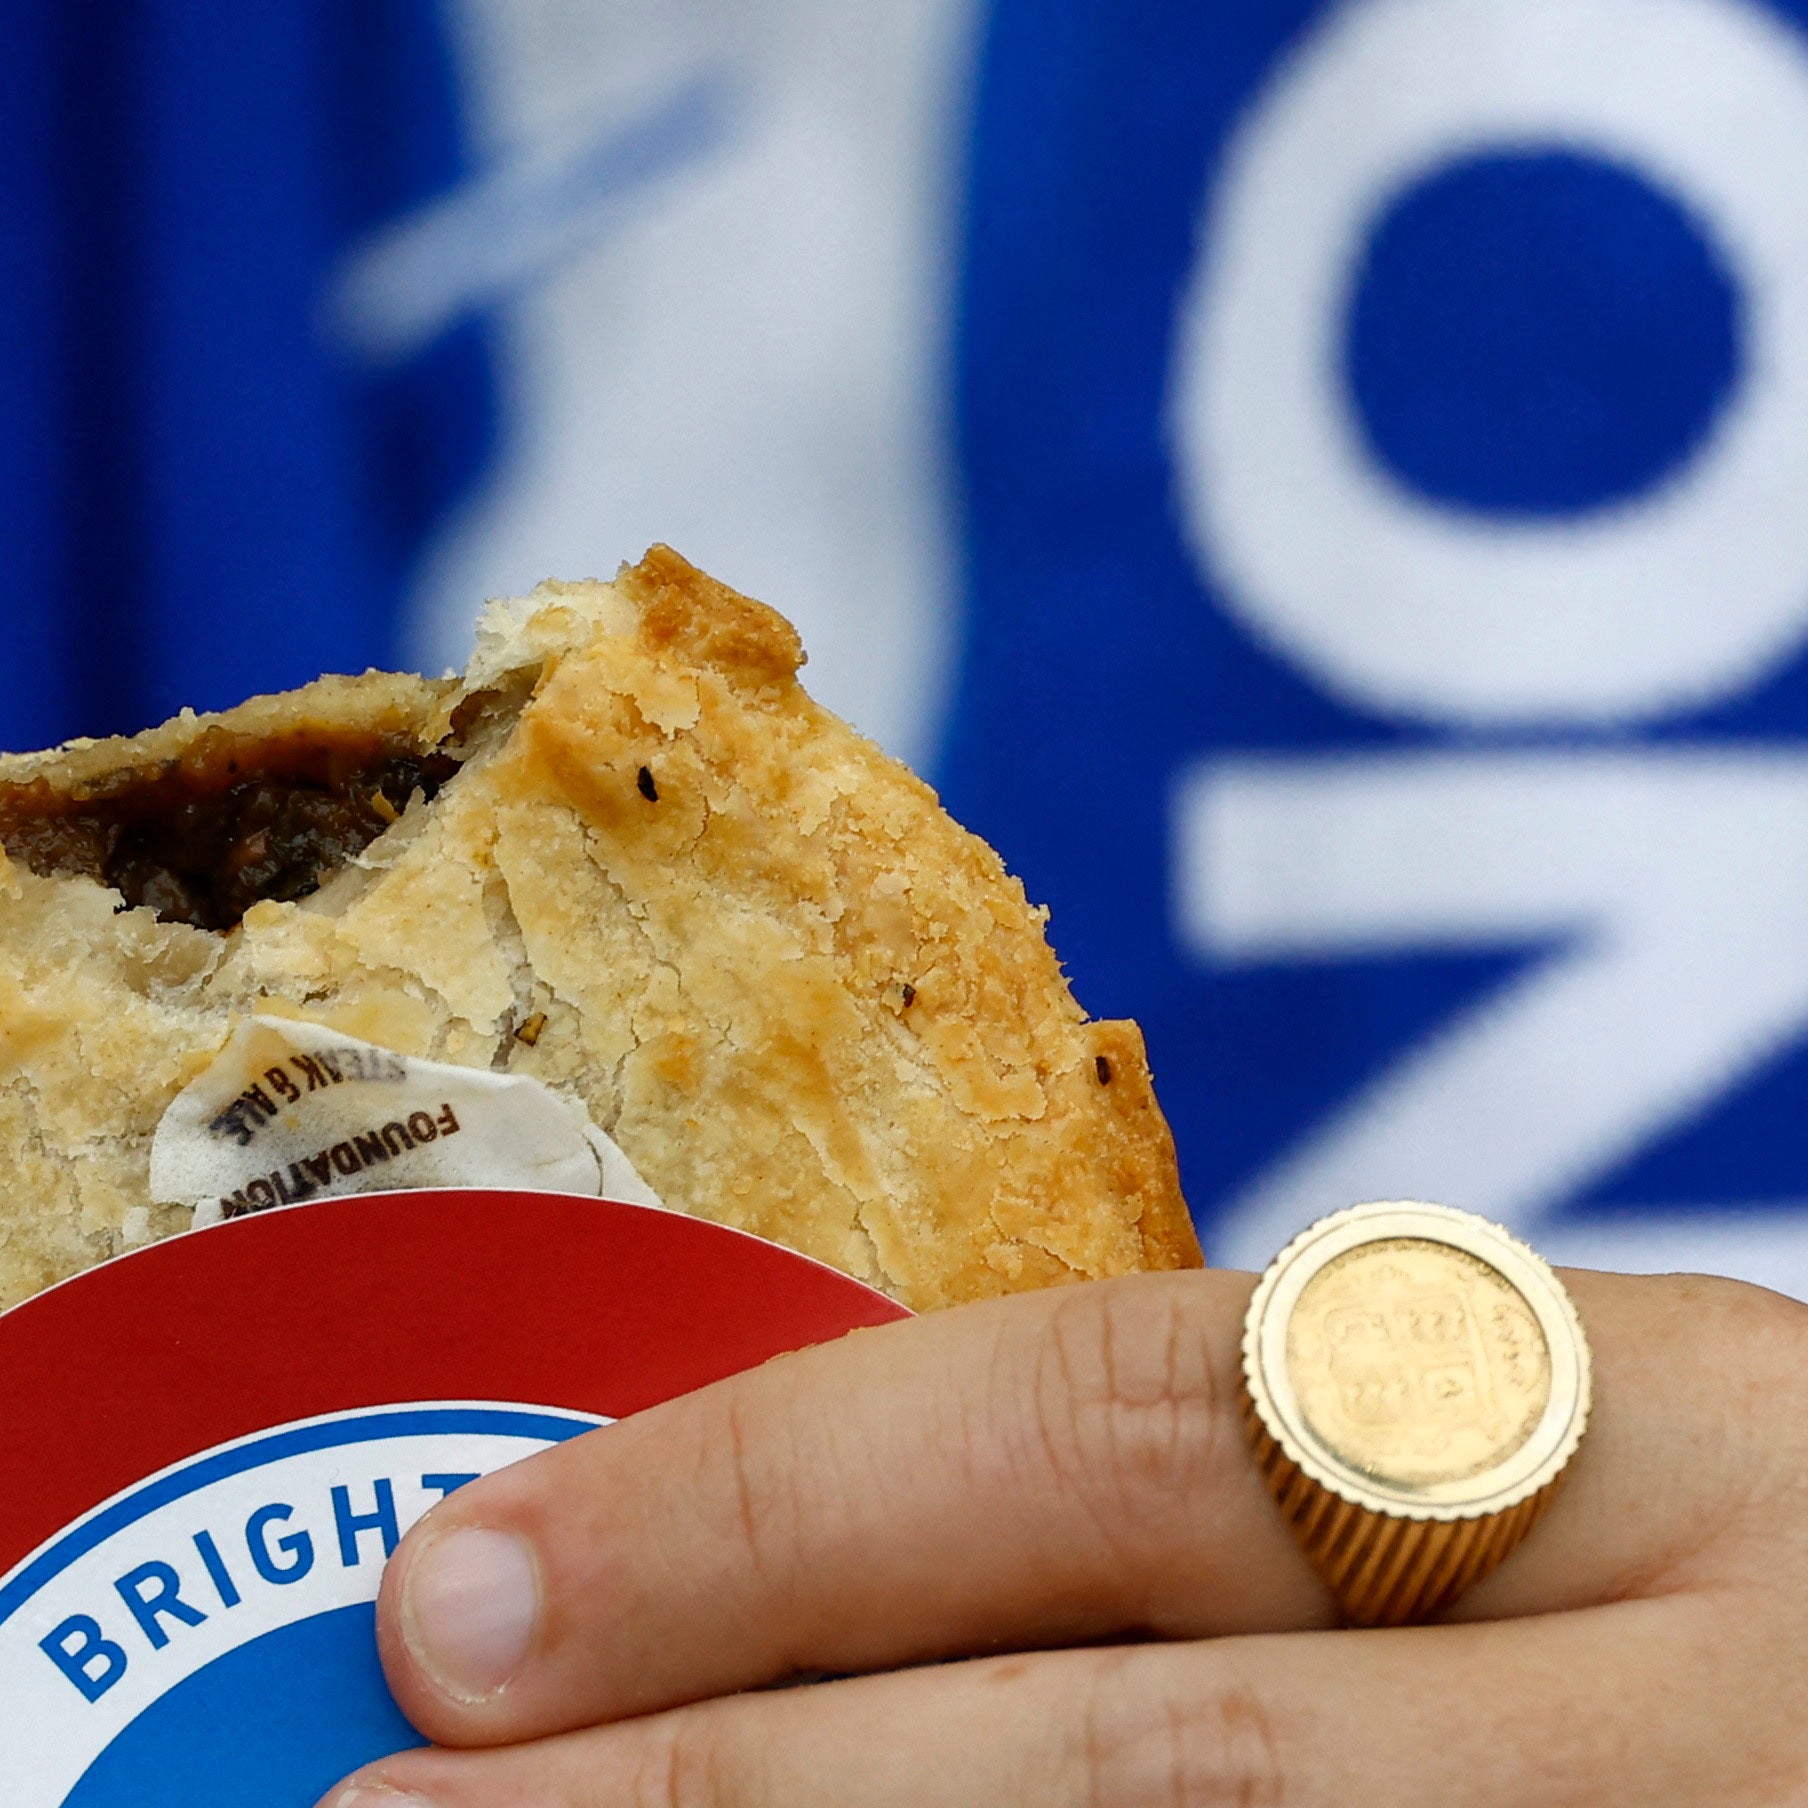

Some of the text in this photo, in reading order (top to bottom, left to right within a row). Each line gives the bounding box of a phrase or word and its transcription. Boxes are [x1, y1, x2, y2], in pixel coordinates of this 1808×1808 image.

[208, 1048, 407, 1146] STEAK & ALE
[219, 1102, 461, 1219] FOUNDATION
